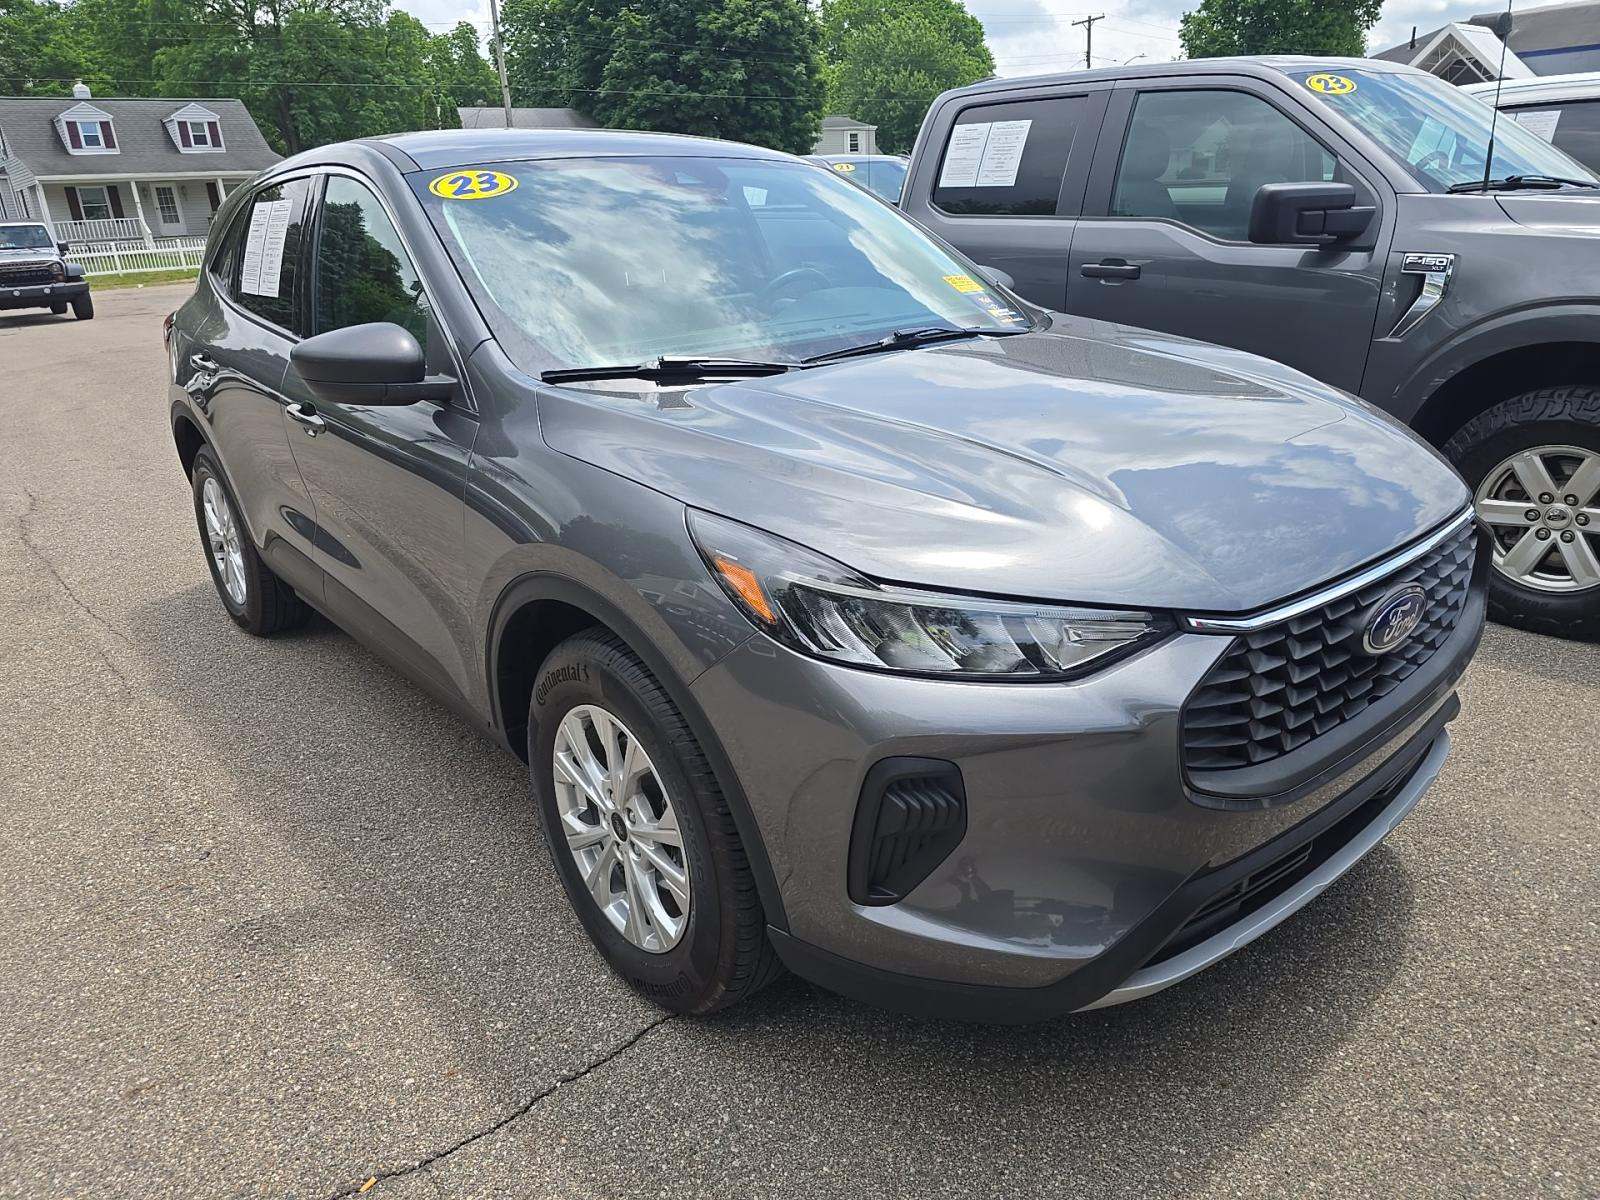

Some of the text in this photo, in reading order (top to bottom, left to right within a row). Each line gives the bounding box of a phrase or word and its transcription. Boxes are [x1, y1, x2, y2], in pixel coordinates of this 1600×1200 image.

[1315, 76, 1347, 91] 23
[447, 172, 500, 196] 23
[1405, 256, 1448, 266] F-150
[1383, 601, 1419, 643] Ford
[535, 662, 582, 705] Continental
